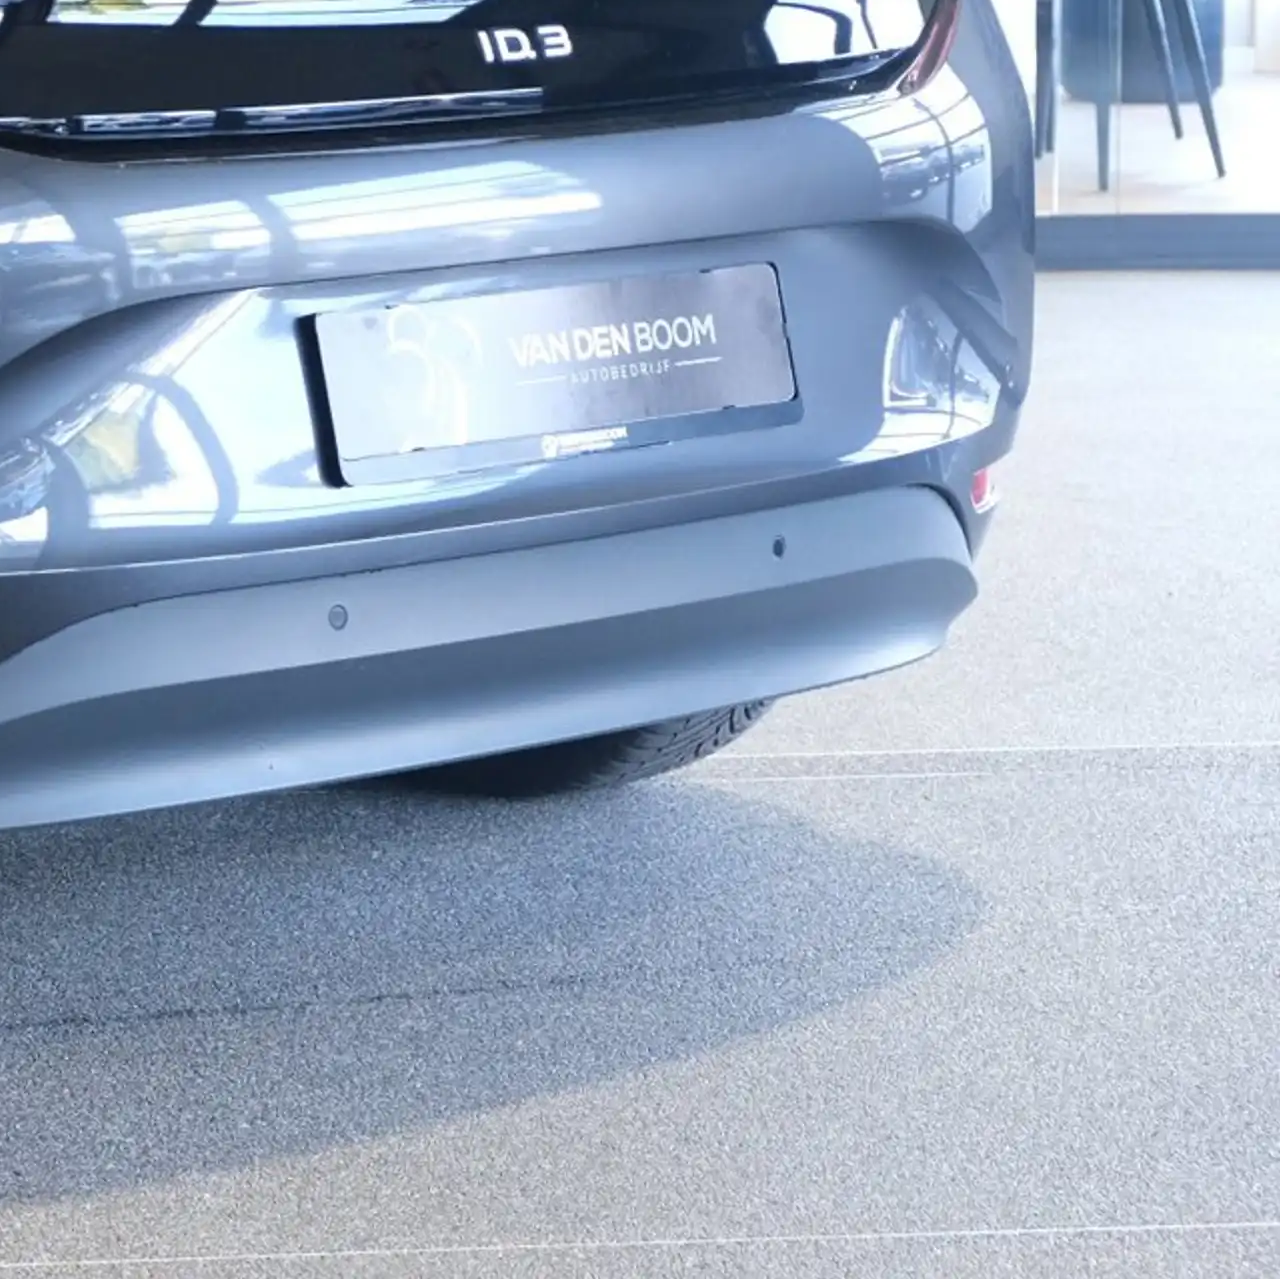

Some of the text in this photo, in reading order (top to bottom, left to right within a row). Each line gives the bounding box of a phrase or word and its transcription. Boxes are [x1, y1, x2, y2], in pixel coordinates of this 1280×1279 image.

[511, 314, 718, 367] VAN DEN BOOM
[571, 359, 671, 384] AUTOBEDRIJF
